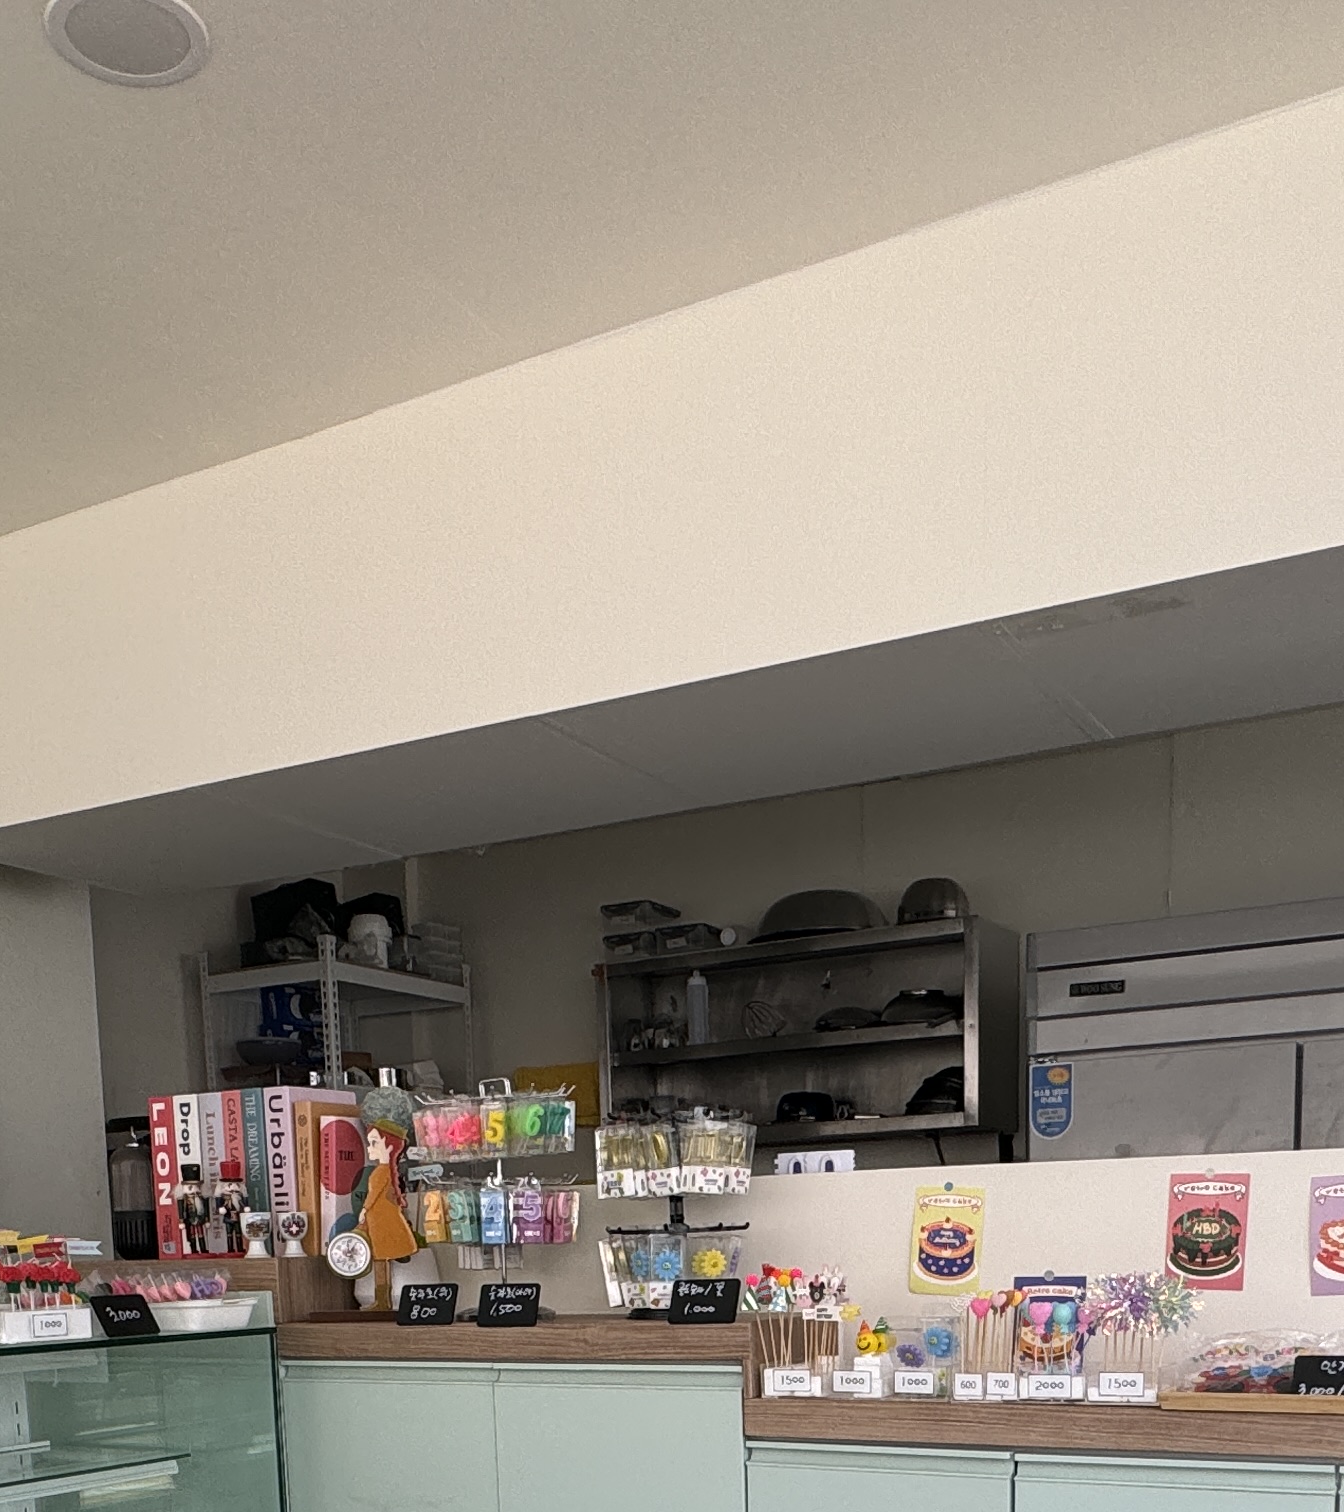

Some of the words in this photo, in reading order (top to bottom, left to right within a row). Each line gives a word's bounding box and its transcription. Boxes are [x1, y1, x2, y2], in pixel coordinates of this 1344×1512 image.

[244, 1094, 256, 1118] THE
[227, 1098, 238, 1143] CASTA
[179, 1102, 191, 1156] Drop
[205, 1111, 219, 1168] Lunch
[152, 1102, 173, 1206] LEON
[246, 1123, 260, 1182] DREAMING
[1212, 1183, 1236, 1192] cake
[1192, 1222, 1221, 1235] HBD
[410, 1304, 437, 1320] 800
[40, 1320, 63, 1330] 1000
[780, 1374, 805, 1386] 1500
[839, 1375, 865, 1386] 1000
[901, 1376, 928, 1388] 1000
[960, 1379, 976, 1390] 600
[993, 1379, 1009, 1390] 700
[1034, 1379, 1065, 1391] 2000
[1108, 1377, 1138, 1390] 1500
